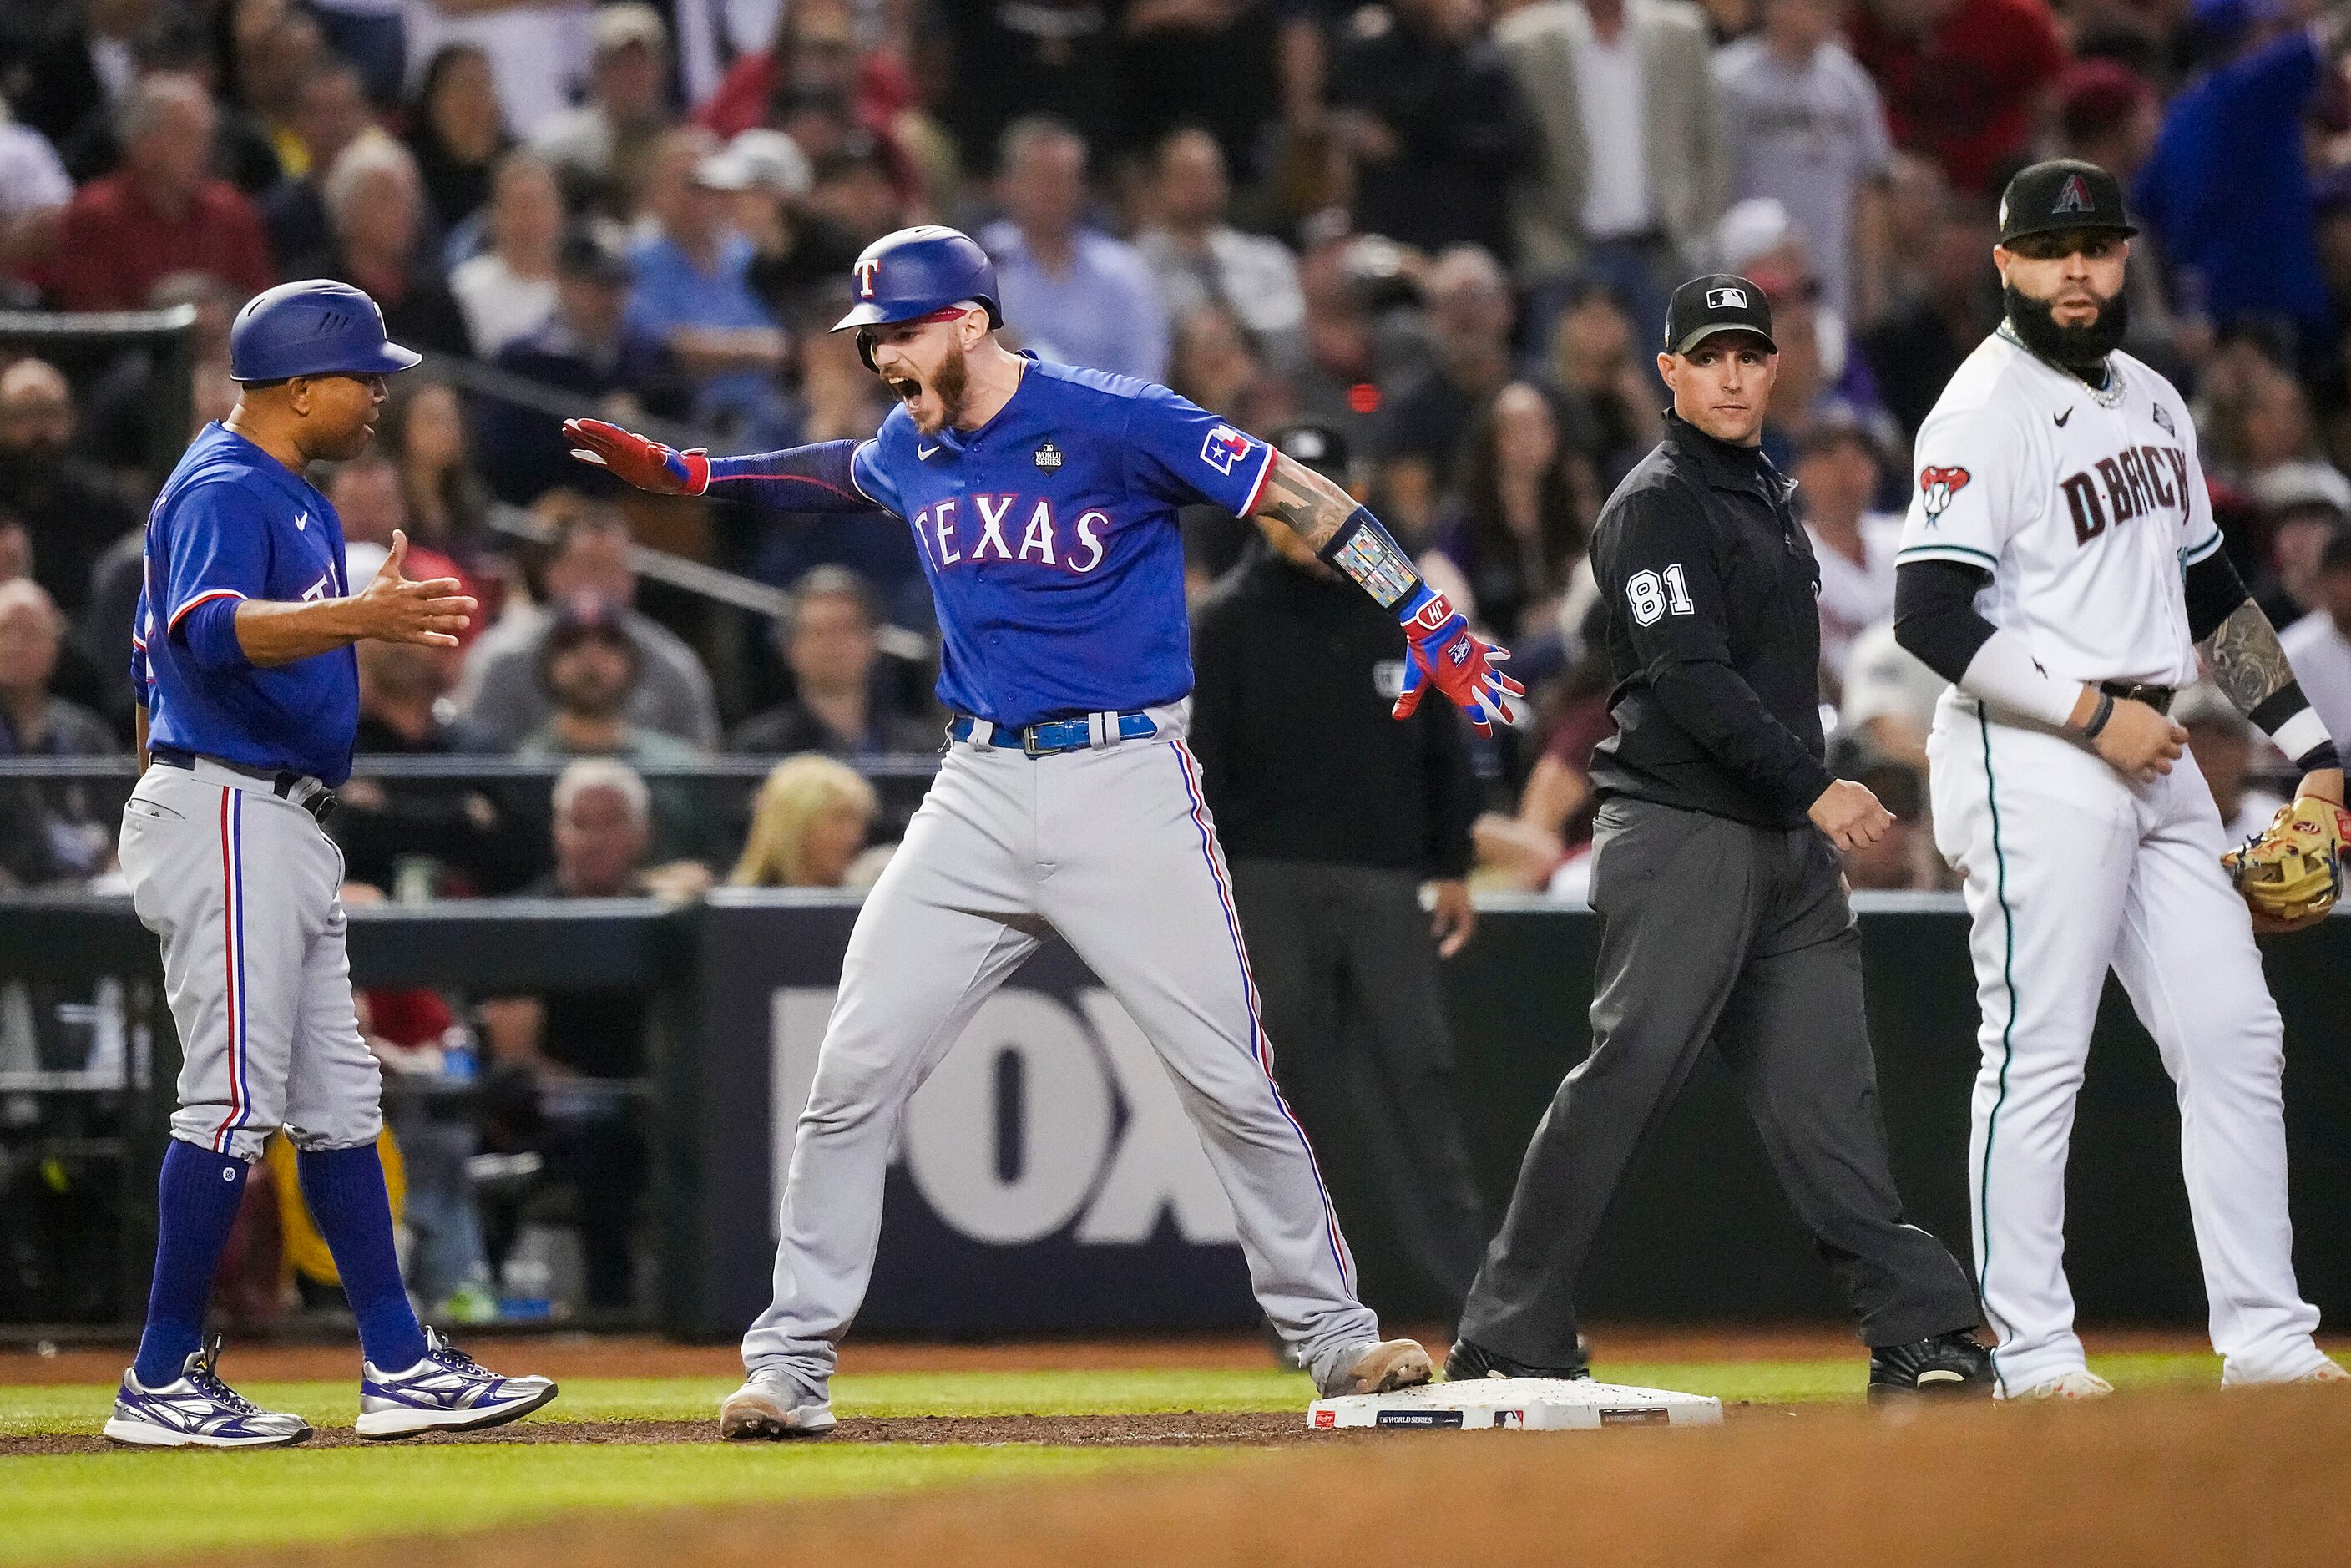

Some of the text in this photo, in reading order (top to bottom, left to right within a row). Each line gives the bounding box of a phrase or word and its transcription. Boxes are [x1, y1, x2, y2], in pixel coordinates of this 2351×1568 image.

[854, 259, 880, 298] T
[913, 494, 1110, 575] TEXAS
[1625, 564, 1695, 627] 81
